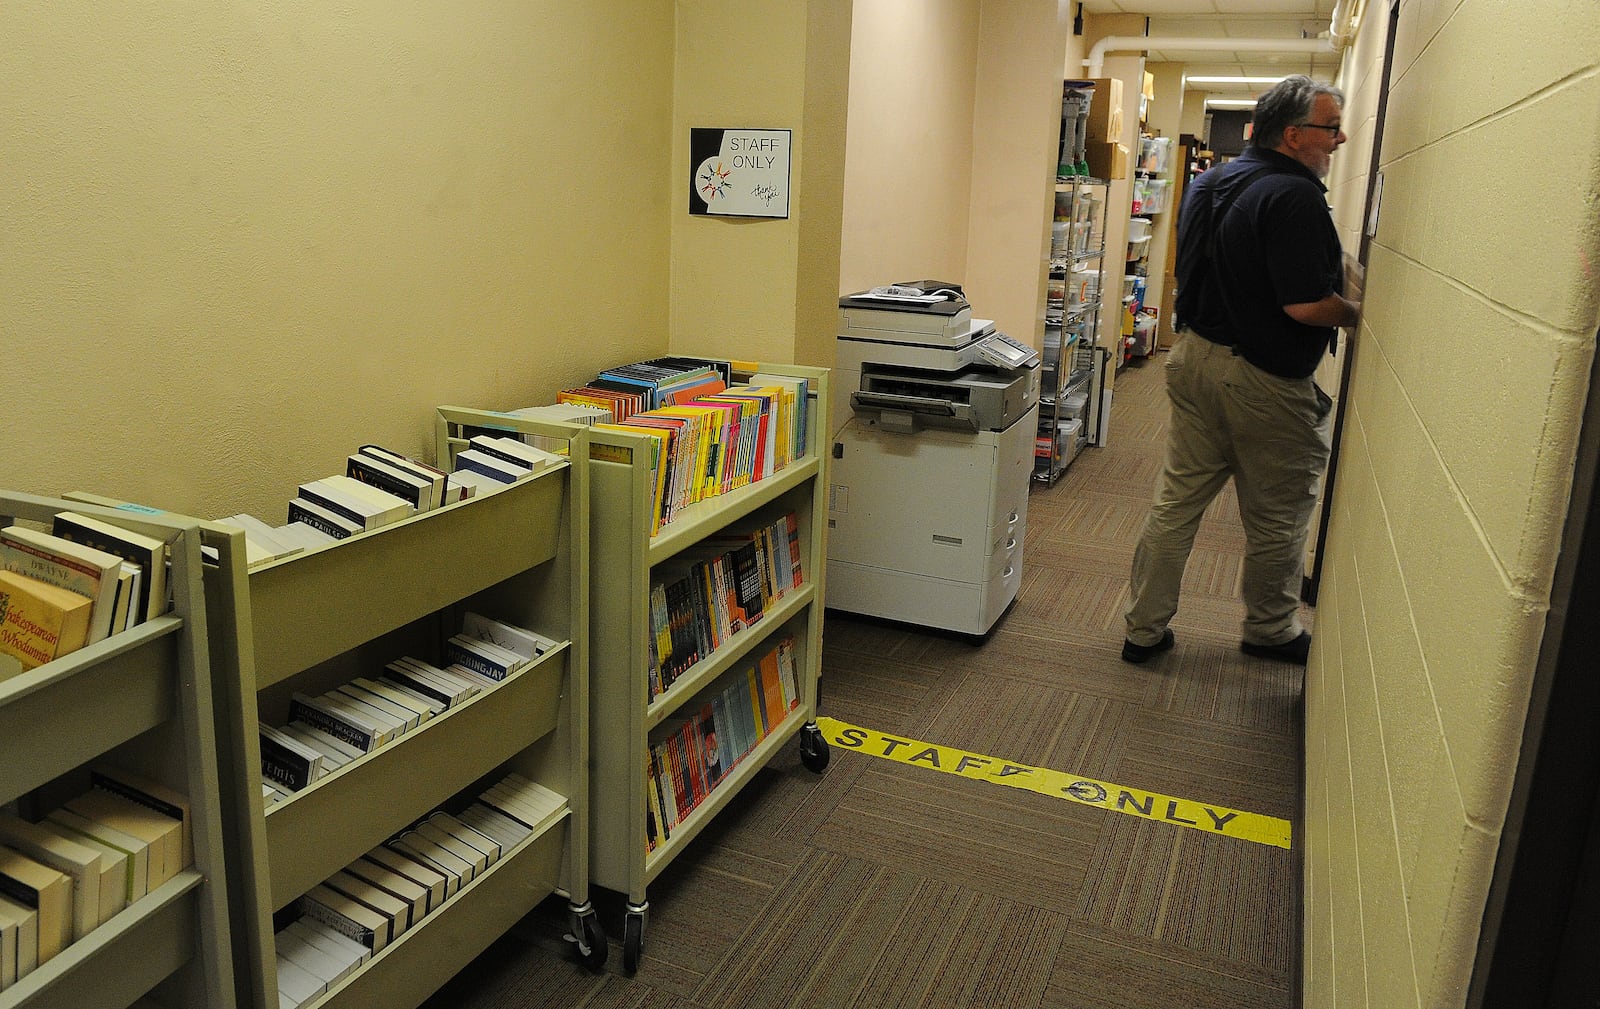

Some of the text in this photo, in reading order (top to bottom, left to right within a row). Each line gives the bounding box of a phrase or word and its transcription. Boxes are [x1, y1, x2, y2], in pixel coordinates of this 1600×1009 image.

[730, 137, 780, 152] STAFF
[732, 155, 775, 169] ONLY
[1060, 780, 1239, 831] ONLY
